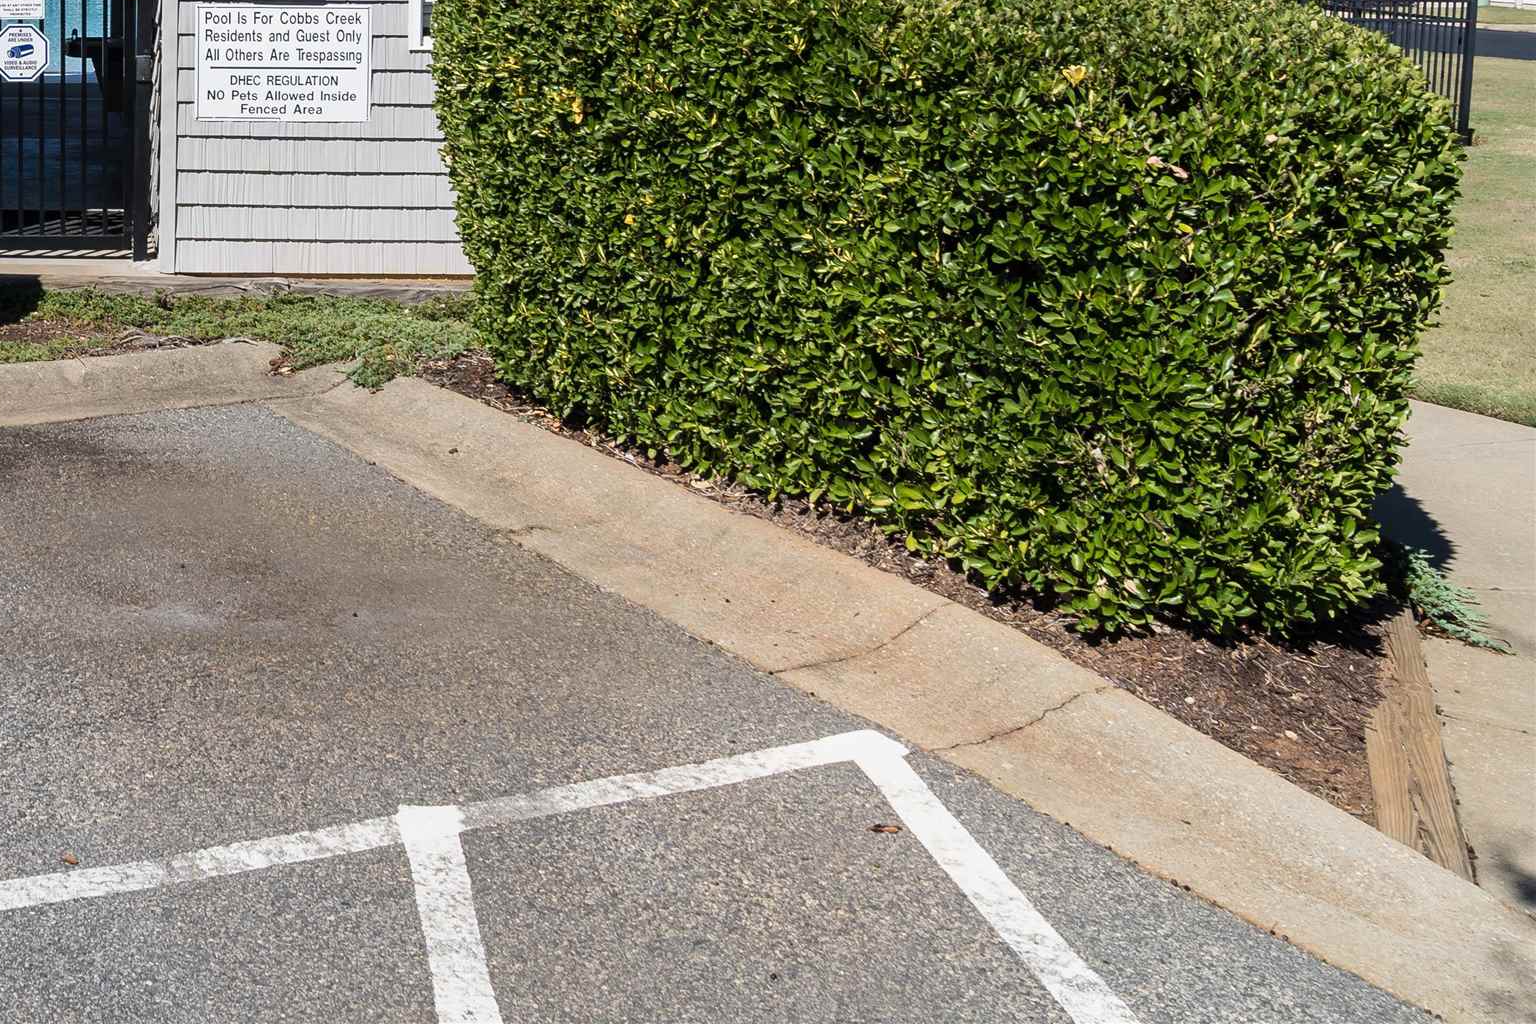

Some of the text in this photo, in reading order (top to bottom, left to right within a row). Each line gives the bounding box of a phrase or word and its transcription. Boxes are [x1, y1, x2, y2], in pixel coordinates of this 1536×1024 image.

[205, 12, 362, 25] Pool Is For Cobbs Creek
[205, 30, 362, 44] Residents and Guest Only
[205, 49, 362, 63] All Others Are Trespassing
[230, 76, 339, 86] DHEC REGULATION
[207, 91, 357, 101] NO Pets Allowed Inside
[240, 104, 323, 115] Fenced Area
